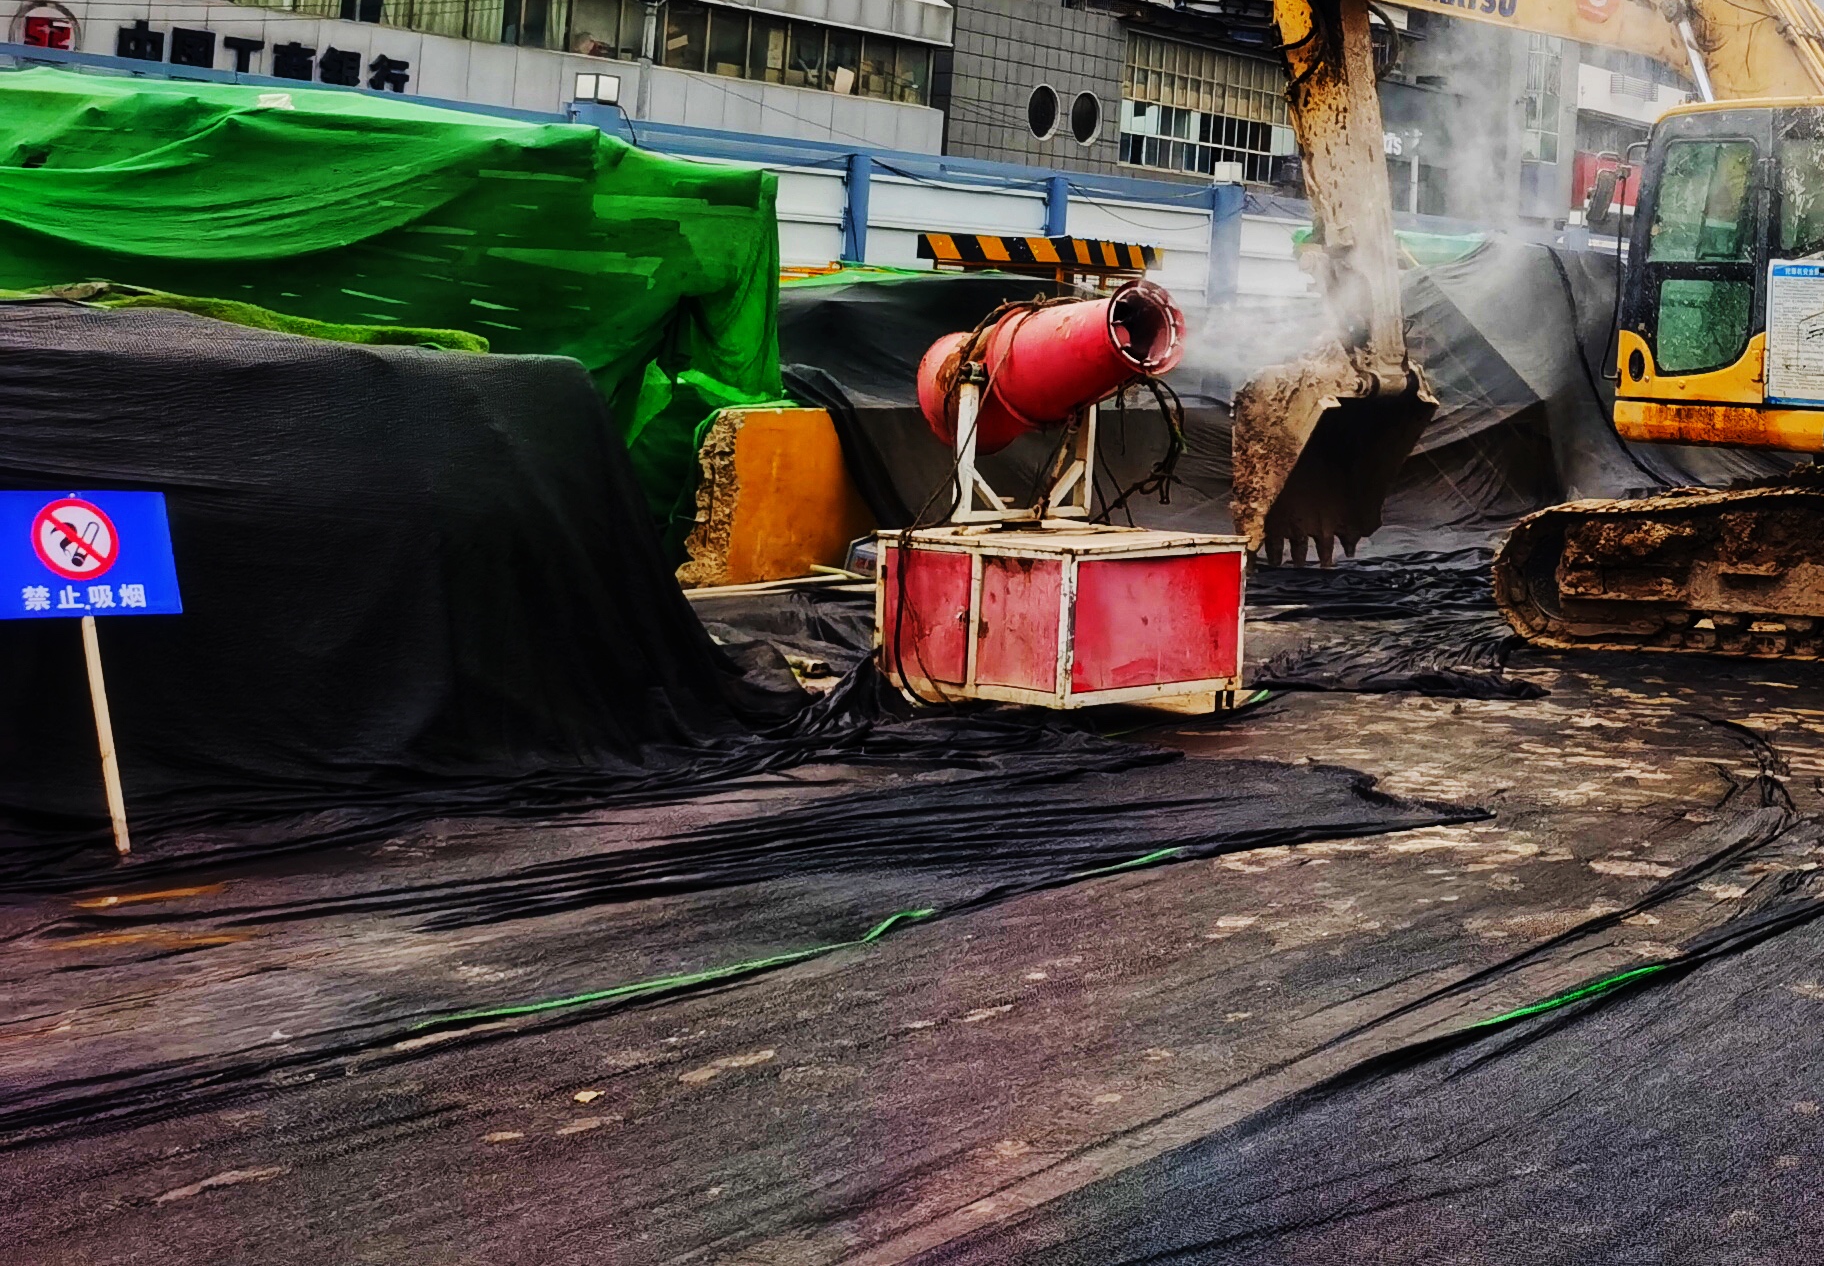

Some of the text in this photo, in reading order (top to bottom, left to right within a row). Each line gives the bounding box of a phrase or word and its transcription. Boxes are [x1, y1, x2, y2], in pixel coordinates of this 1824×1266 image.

[116, 19, 410, 94] 中国工商银行
[22, 584, 147, 611] 禁止吸烟
